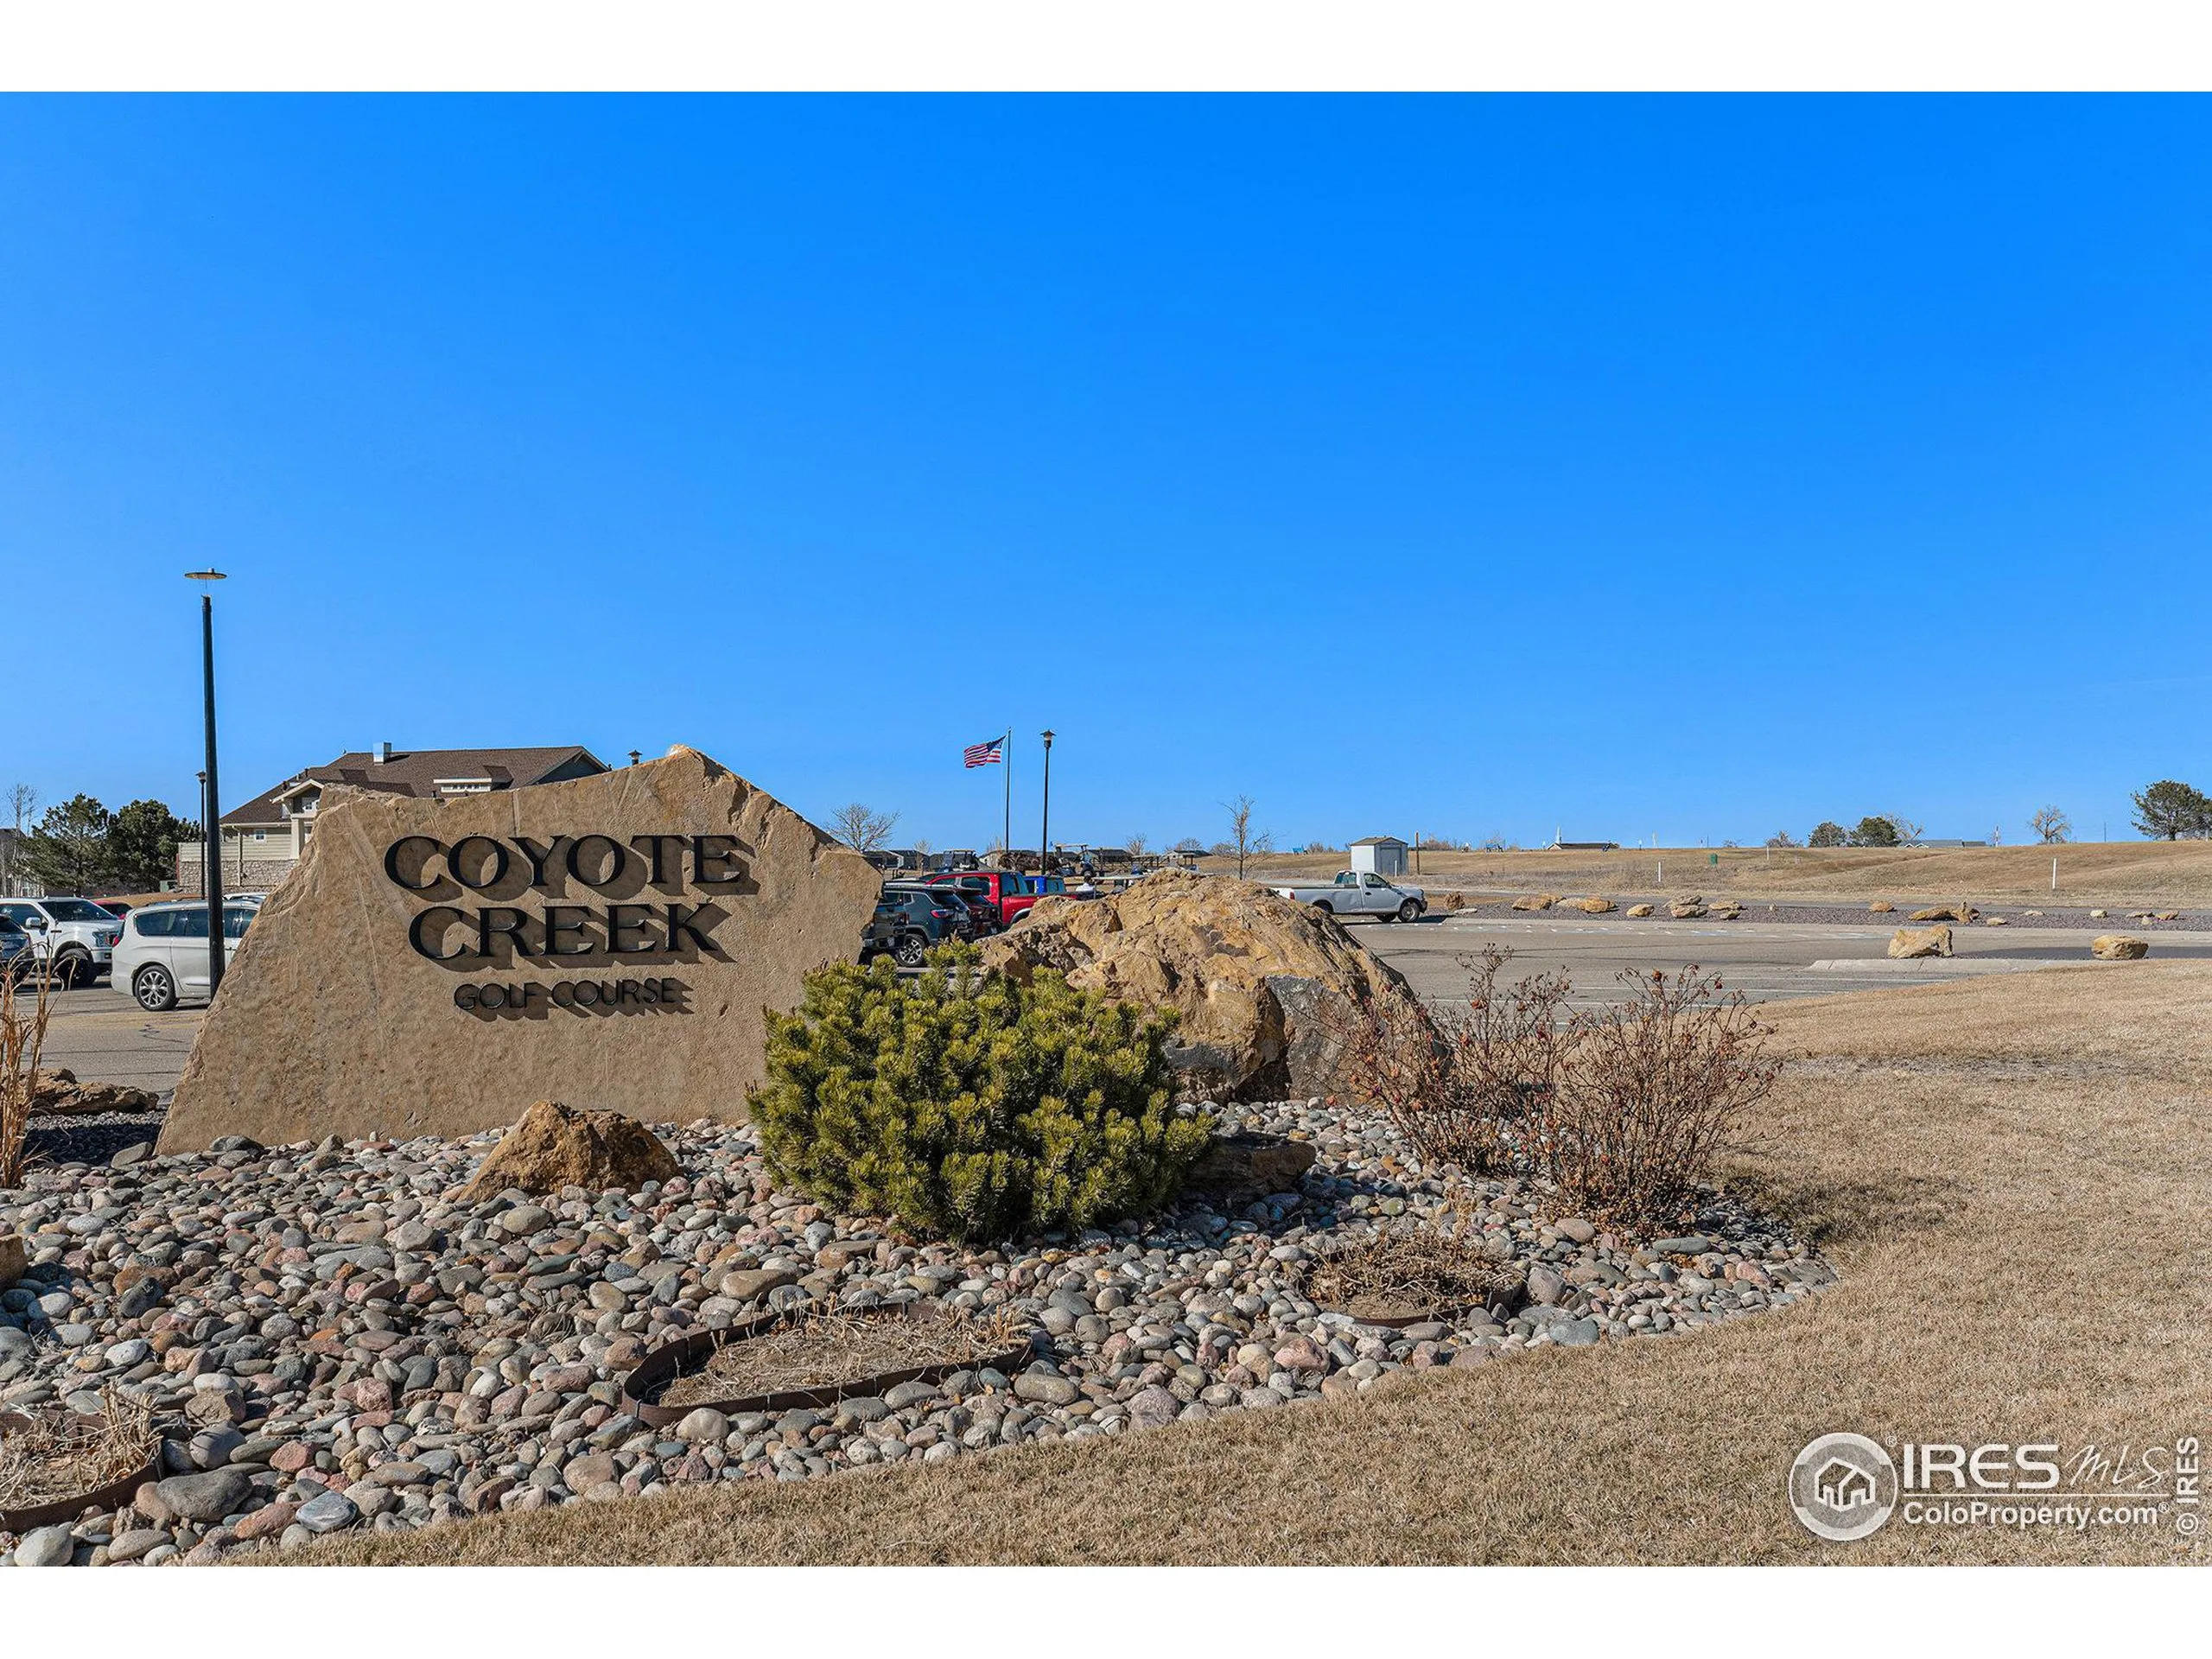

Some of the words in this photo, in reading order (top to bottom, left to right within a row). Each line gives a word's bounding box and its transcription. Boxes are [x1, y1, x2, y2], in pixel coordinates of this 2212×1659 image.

[384, 835, 741, 889] COYOTE
[408, 903, 718, 960] CREEK
[454, 982, 539, 1010] GOLF
[550, 978, 677, 1007] COURSE
